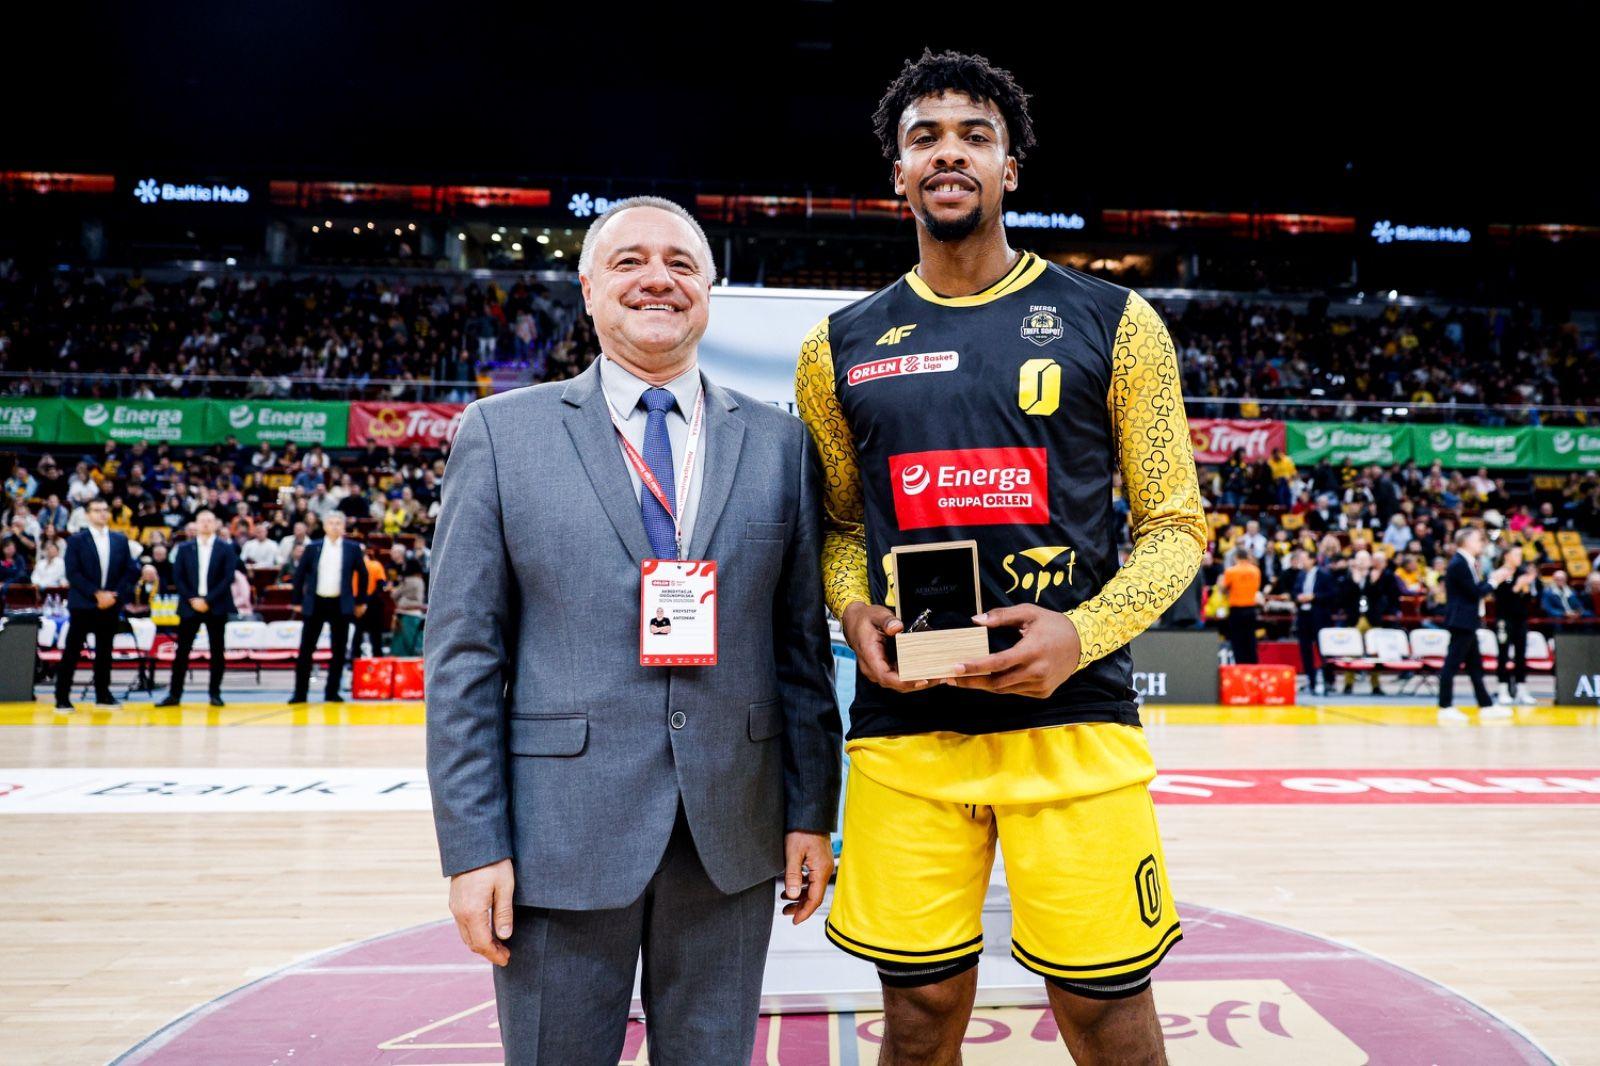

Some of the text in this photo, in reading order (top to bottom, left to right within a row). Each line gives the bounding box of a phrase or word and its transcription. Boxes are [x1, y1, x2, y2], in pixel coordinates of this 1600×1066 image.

[162, 183, 249, 202] Baltic Hub
[1005, 210, 1085, 229] Baltic Hub
[1395, 225, 1471, 242] Baltic Hub
[923, 354, 953, 362] Basket
[851, 361, 897, 380] ORLEN
[1018, 358, 1062, 416] 0
[113, 406, 183, 427] Energa
[258, 408, 327, 428] Energa
[937, 466, 1031, 492] Energa
[938, 495, 1029, 507] GRUPA ORLEN
[1002, 550, 1076, 603] Sopot
[1135, 854, 1163, 928] 0
